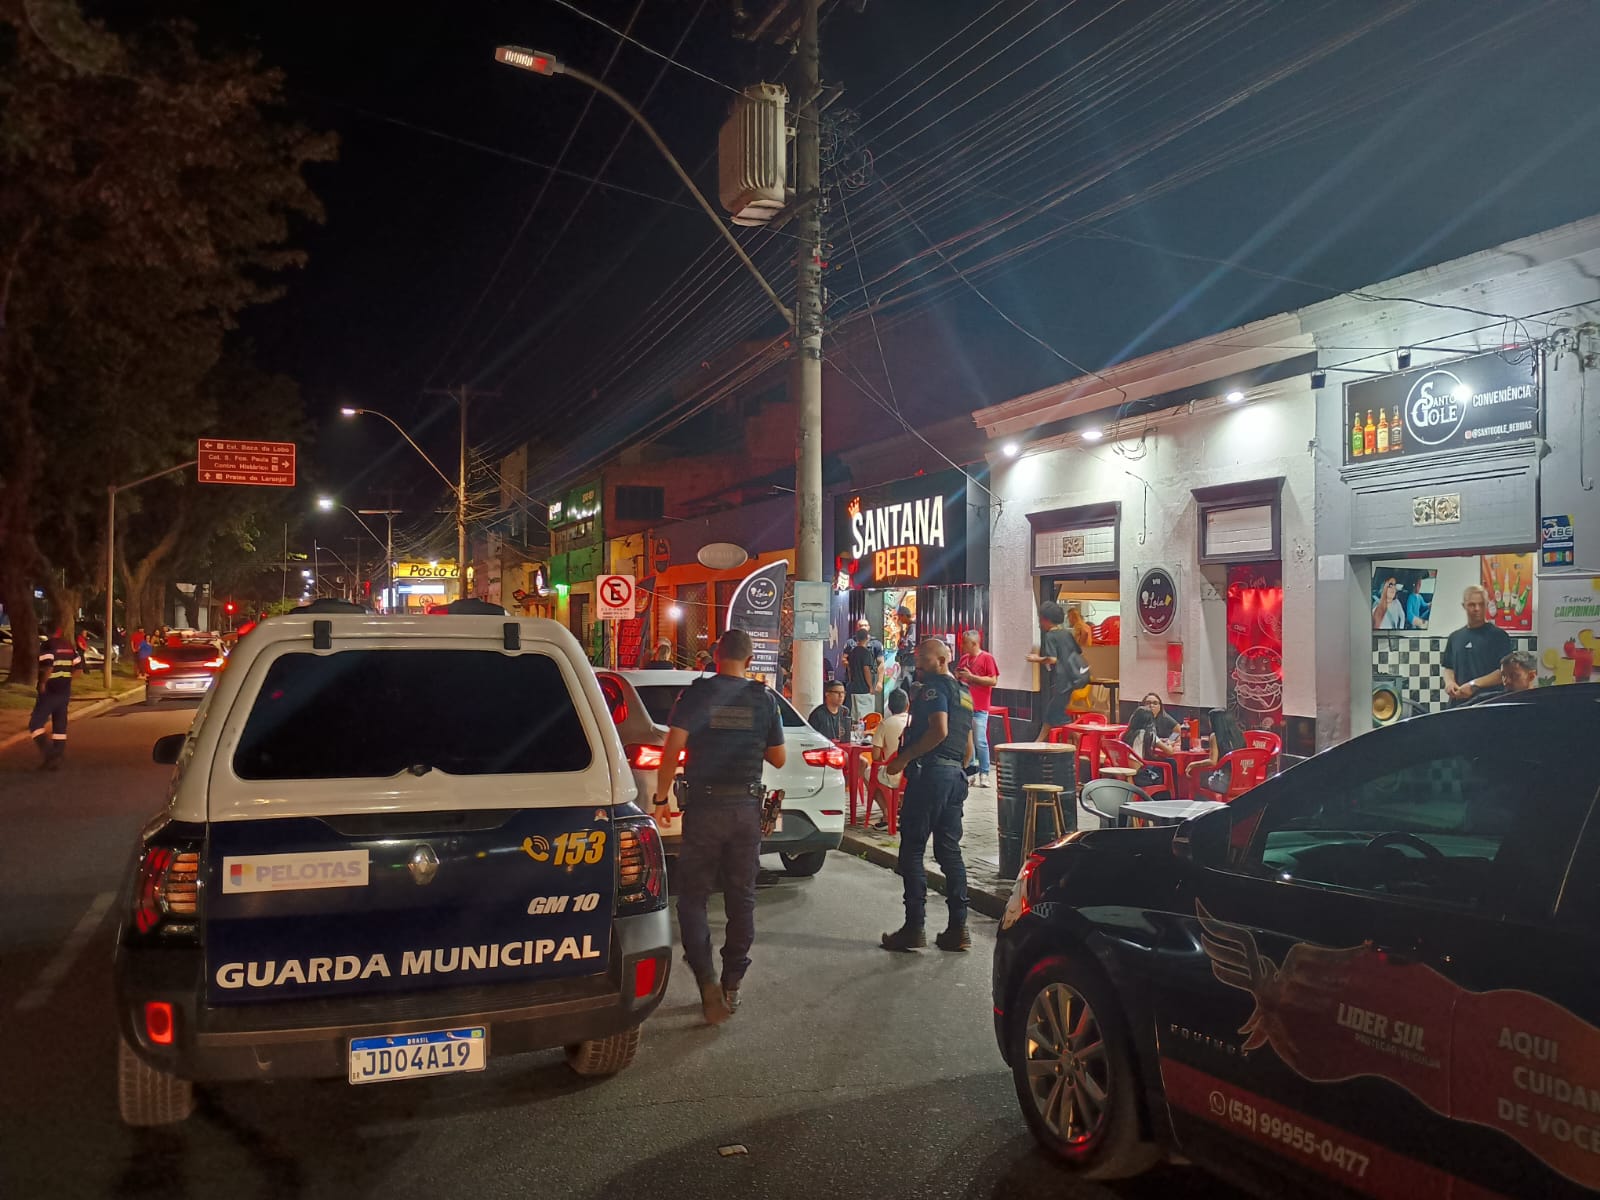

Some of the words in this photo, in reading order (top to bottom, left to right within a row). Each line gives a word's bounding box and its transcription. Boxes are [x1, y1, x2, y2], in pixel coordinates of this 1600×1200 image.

[1472, 385, 1531, 407] CONVENIÊNCIA
[261, 475, 287, 483] Laranjal
[852, 495, 945, 559] SANTANA
[409, 564, 447, 577] Posto
[875, 545, 919, 581] BEER
[553, 831, 606, 865] 153
[256, 861, 361, 883] PELOTAS
[528, 896, 569, 915] GM
[573, 893, 600, 912] 10
[215, 953, 391, 989] GUARDA
[400, 935, 600, 976] MUNICIPAL
[407, 1037, 429, 1045] BRASIL
[1337, 1002, 1388, 1039] LIDER
[1391, 1020, 1425, 1053] SUL
[1498, 1026, 1559, 1064] AQUI
[1497, 1096, 1529, 1128] DE
[1229, 1098, 1257, 1133] (53)
[1260, 1112, 1370, 1177] 99955-0477
